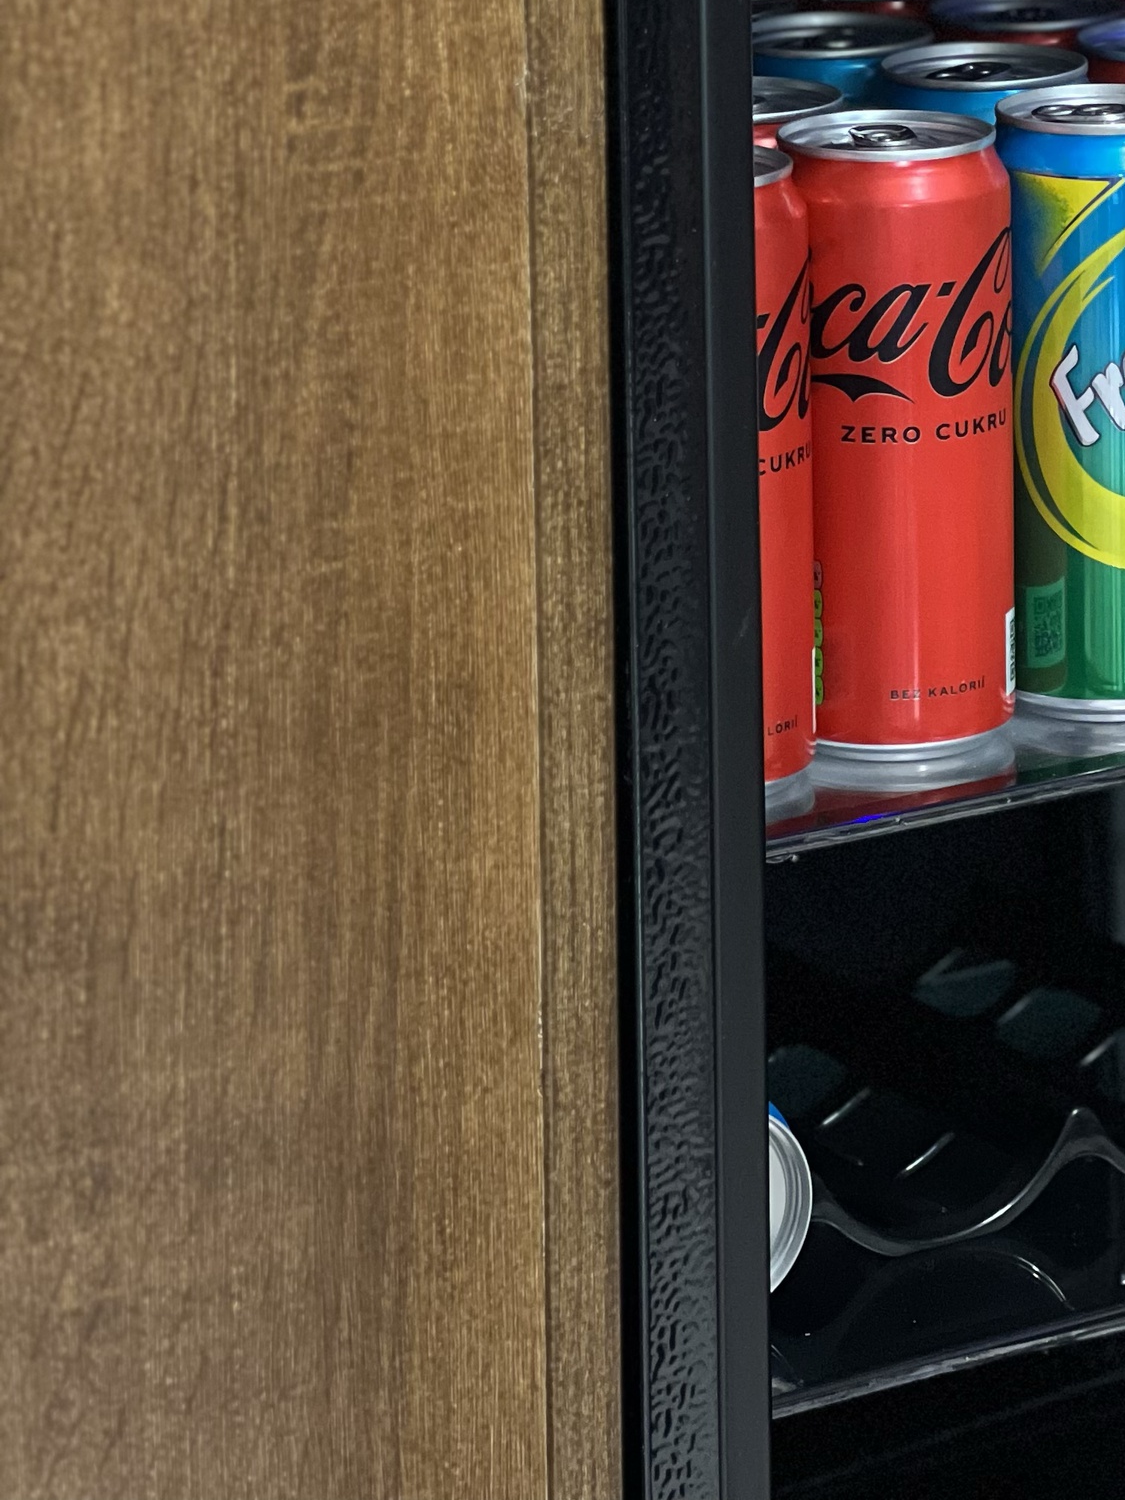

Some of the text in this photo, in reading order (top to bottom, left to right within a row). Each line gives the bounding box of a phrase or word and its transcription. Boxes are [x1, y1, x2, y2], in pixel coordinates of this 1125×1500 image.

[841, 408, 1007, 444] ZERO CUKRU
[890, 675, 986, 700] BEZ KALORIÍ
